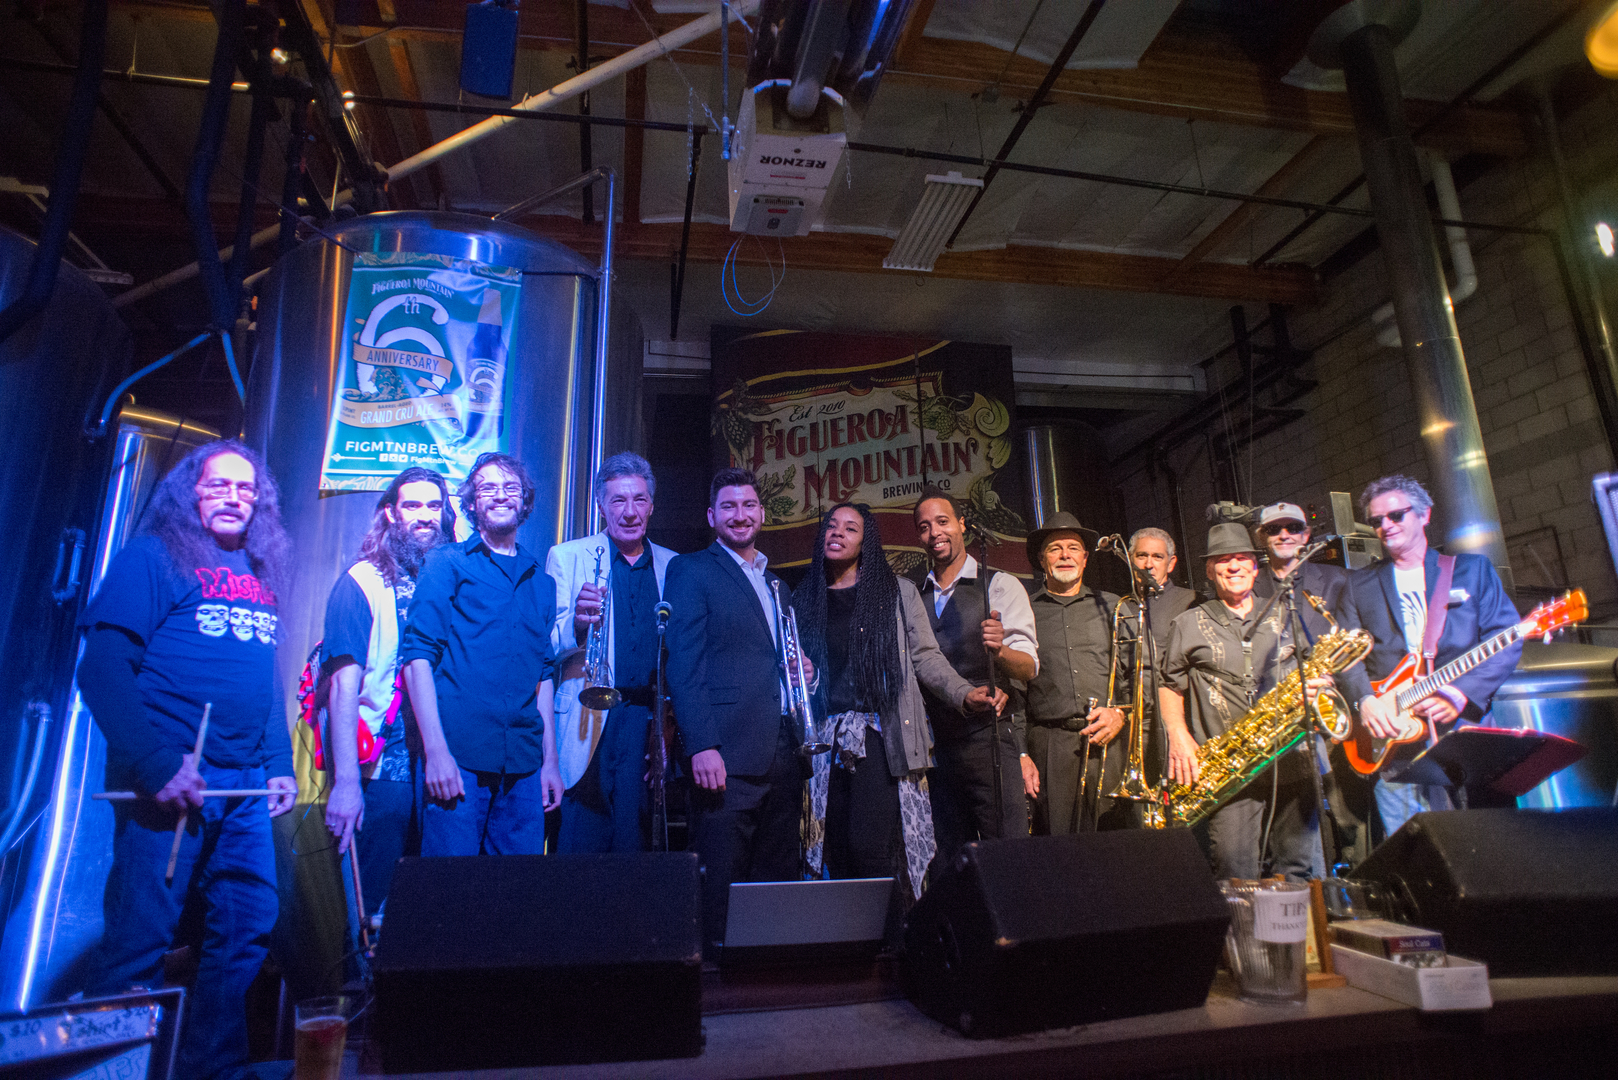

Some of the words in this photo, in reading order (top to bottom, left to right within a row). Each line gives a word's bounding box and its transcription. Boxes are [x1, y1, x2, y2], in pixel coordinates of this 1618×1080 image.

[759, 155, 827, 169] REZNOR
[371, 278, 411, 295] FIGUEROA
[366, 349, 440, 373] ANNIVERSARY
[360, 410, 393, 424] GRAND
[395, 405, 414, 421] CRU
[415, 403, 434, 417] ALE
[816, 399, 846, 416] 2010
[751, 404, 910, 473] FIGUEROA
[345, 441, 481, 459] FIGMTNBREW.CO
[801, 438, 980, 514] MOUNTAIN
[882, 480, 934, 500] BREWIN
